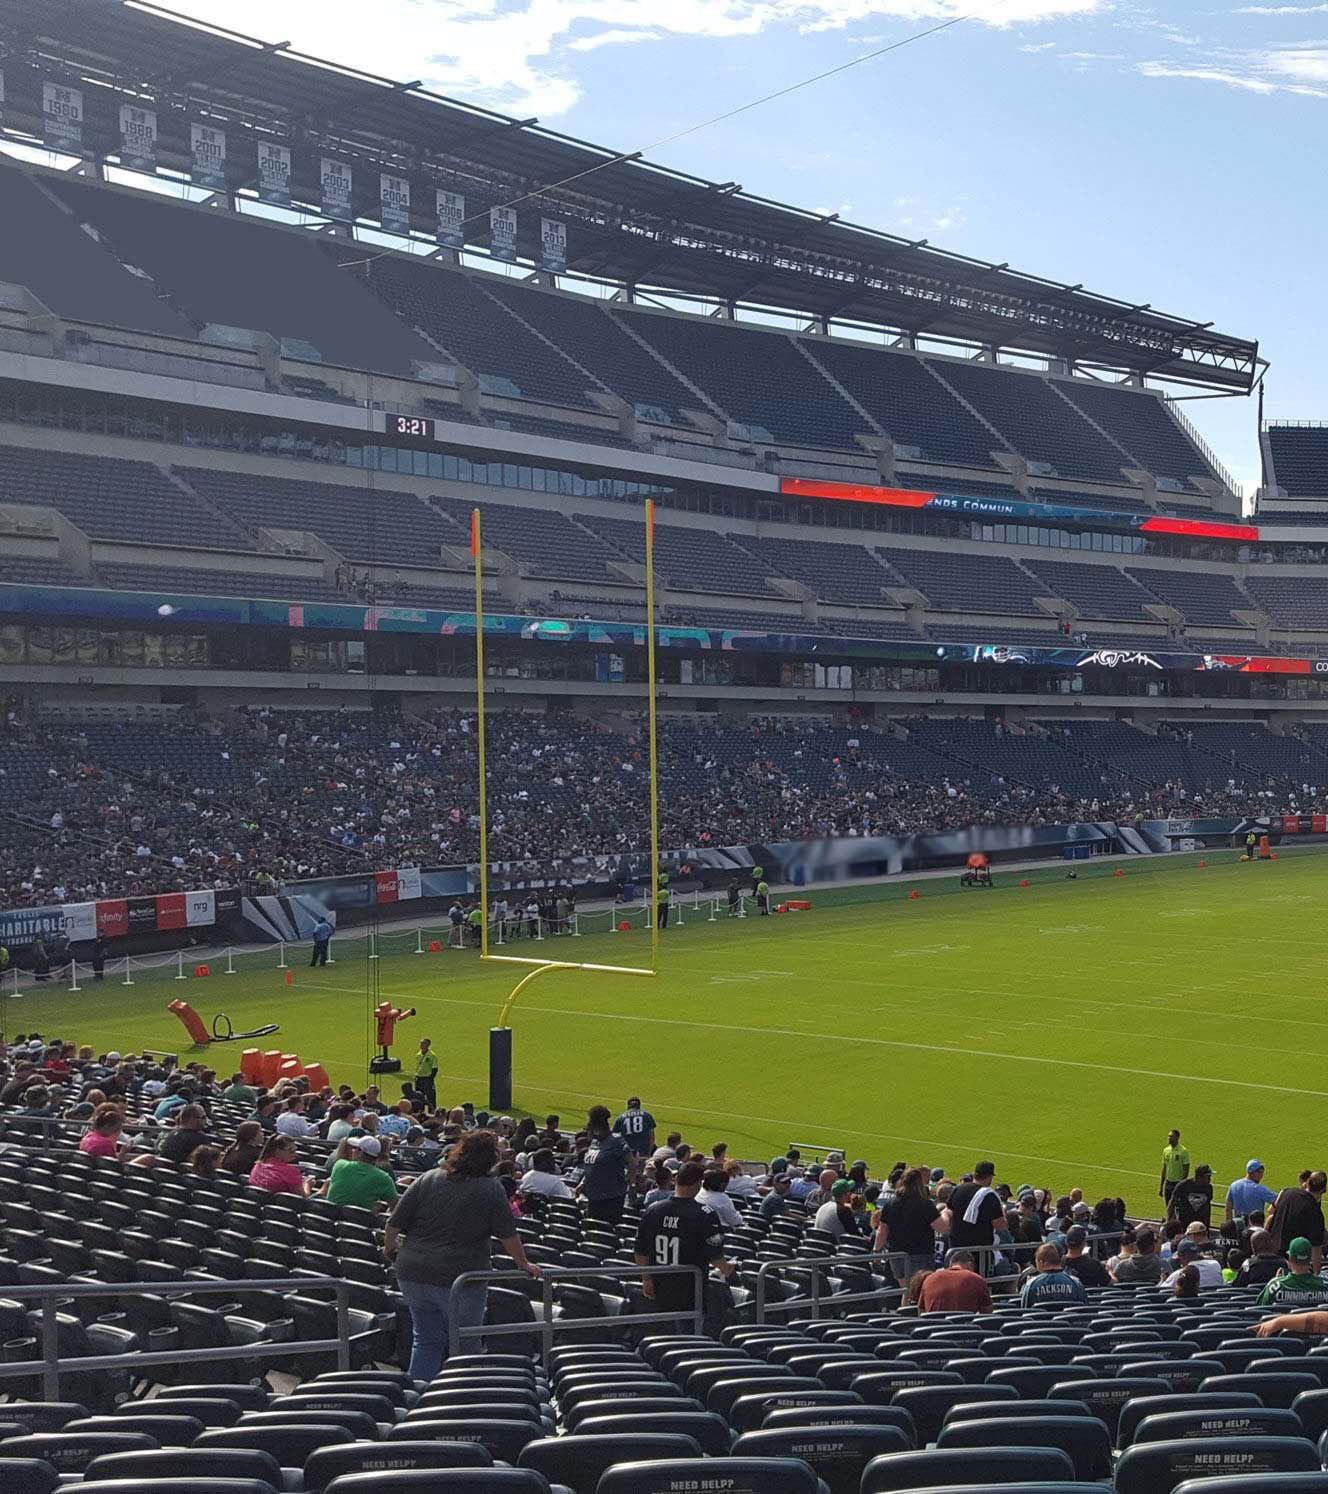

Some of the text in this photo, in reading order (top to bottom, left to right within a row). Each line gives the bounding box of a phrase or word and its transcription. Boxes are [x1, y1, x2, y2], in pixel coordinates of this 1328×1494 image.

[194, 139, 222, 156] 2001
[261, 156, 288, 172] 2002
[323, 172, 350, 189] 2003
[382, 189, 408, 205] 2004
[493, 219, 515, 233] 2010
[543, 231, 565, 245] 2013
[398, 417, 426, 436] 3:21
[193, 901, 208, 913] nrg
[622, 1116, 644, 1135] 18
[663, 1216, 680, 1229] COX
[655, 1235, 680, 1266] 91
[1036, 1283, 1073, 1296] JACKSON
[1202, 1421, 1222, 1429] NEED
[792, 1444, 813, 1453] NEED
[1195, 1454, 1254, 1463] NEED HELP?
[670, 1479, 734, 1490] NEED HELP?
